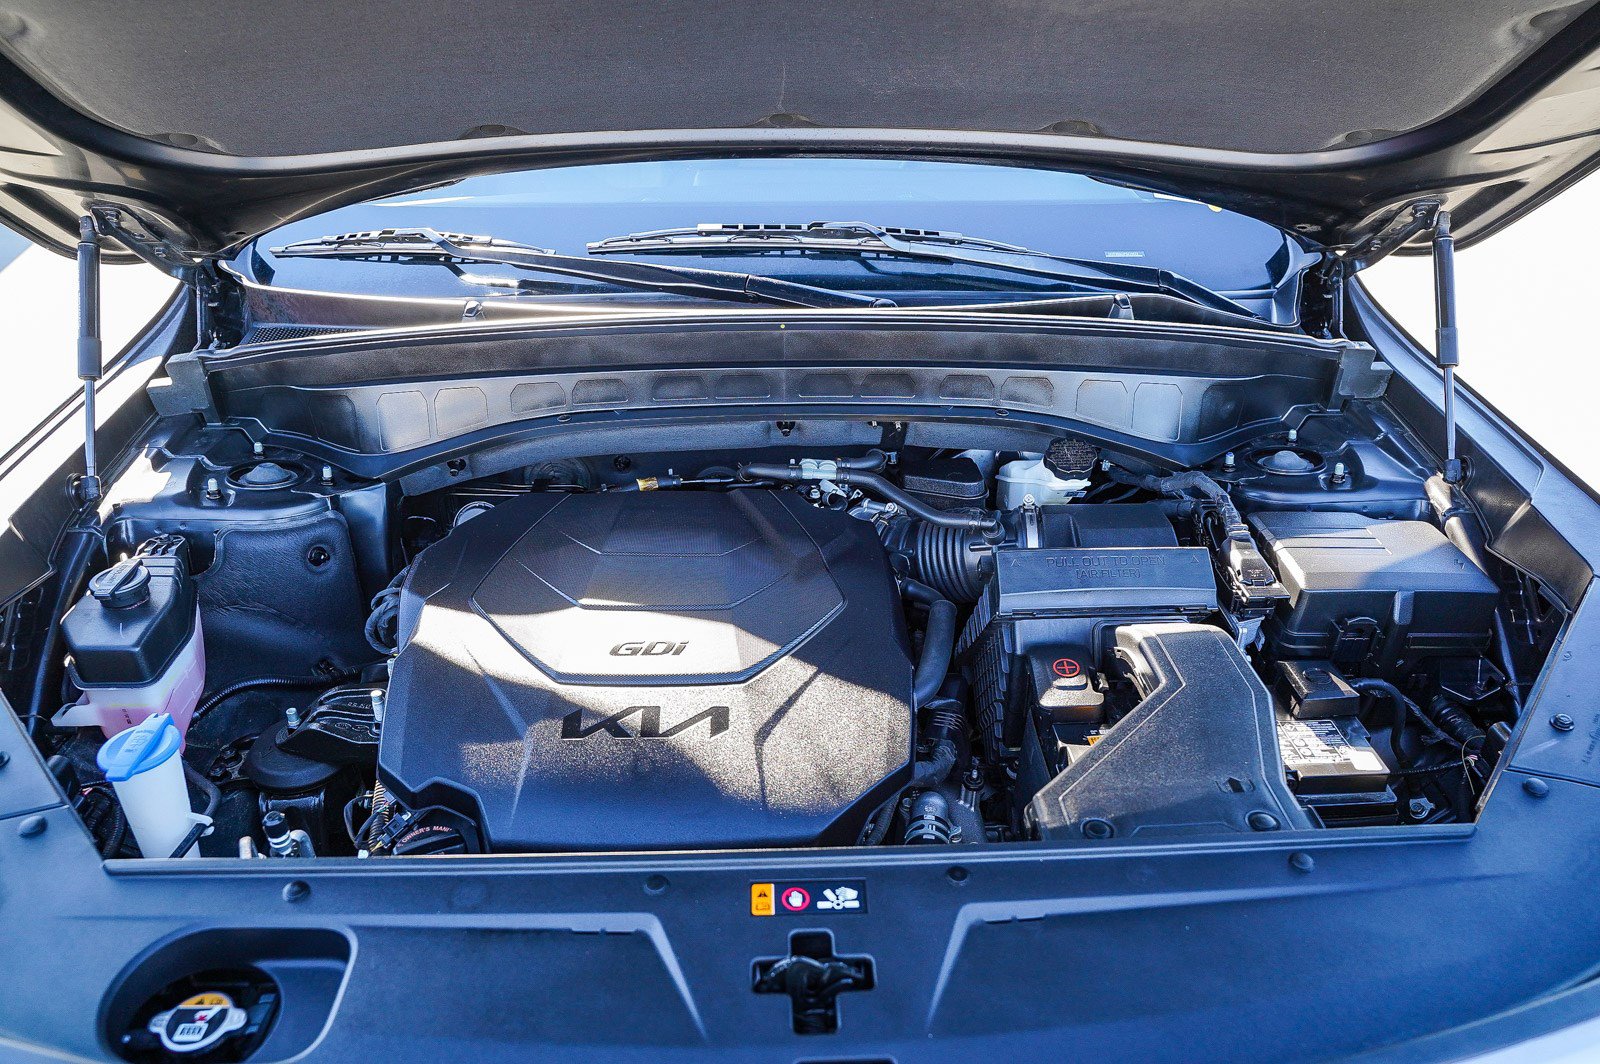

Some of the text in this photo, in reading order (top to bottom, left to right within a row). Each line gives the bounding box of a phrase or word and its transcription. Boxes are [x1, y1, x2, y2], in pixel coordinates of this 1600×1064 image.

[1046, 555, 1165, 568] PULL OUT TO OPEN
[609, 640, 690, 657] GDi
[560, 705, 730, 740] KIA
[401, 826, 431, 843] OWNER'S
